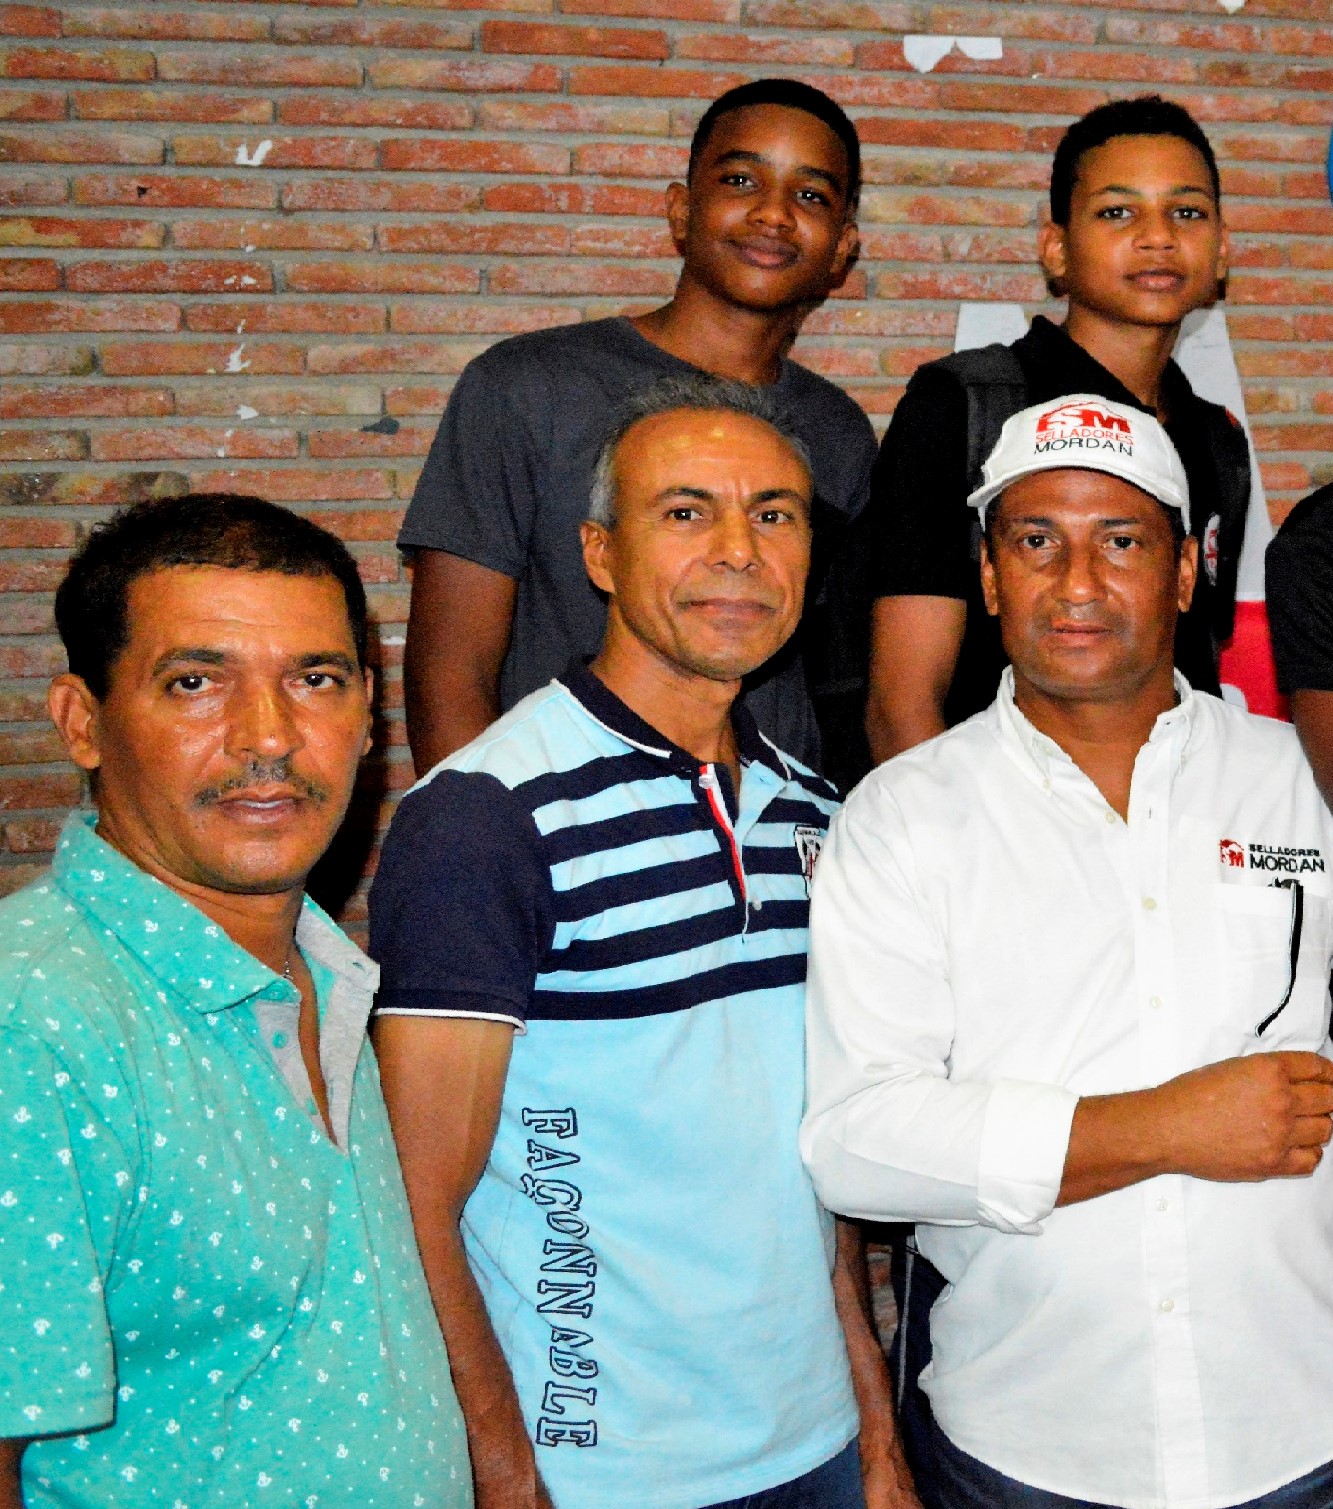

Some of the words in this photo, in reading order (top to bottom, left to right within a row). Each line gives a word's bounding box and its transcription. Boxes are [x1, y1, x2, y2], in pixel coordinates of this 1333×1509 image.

[1036, 428, 1134, 446] SELLADORES
[1034, 437, 1133, 457] MORDAN
[1248, 844, 1320, 857] SELLADORES
[1249, 853, 1325, 873] MORDAN
